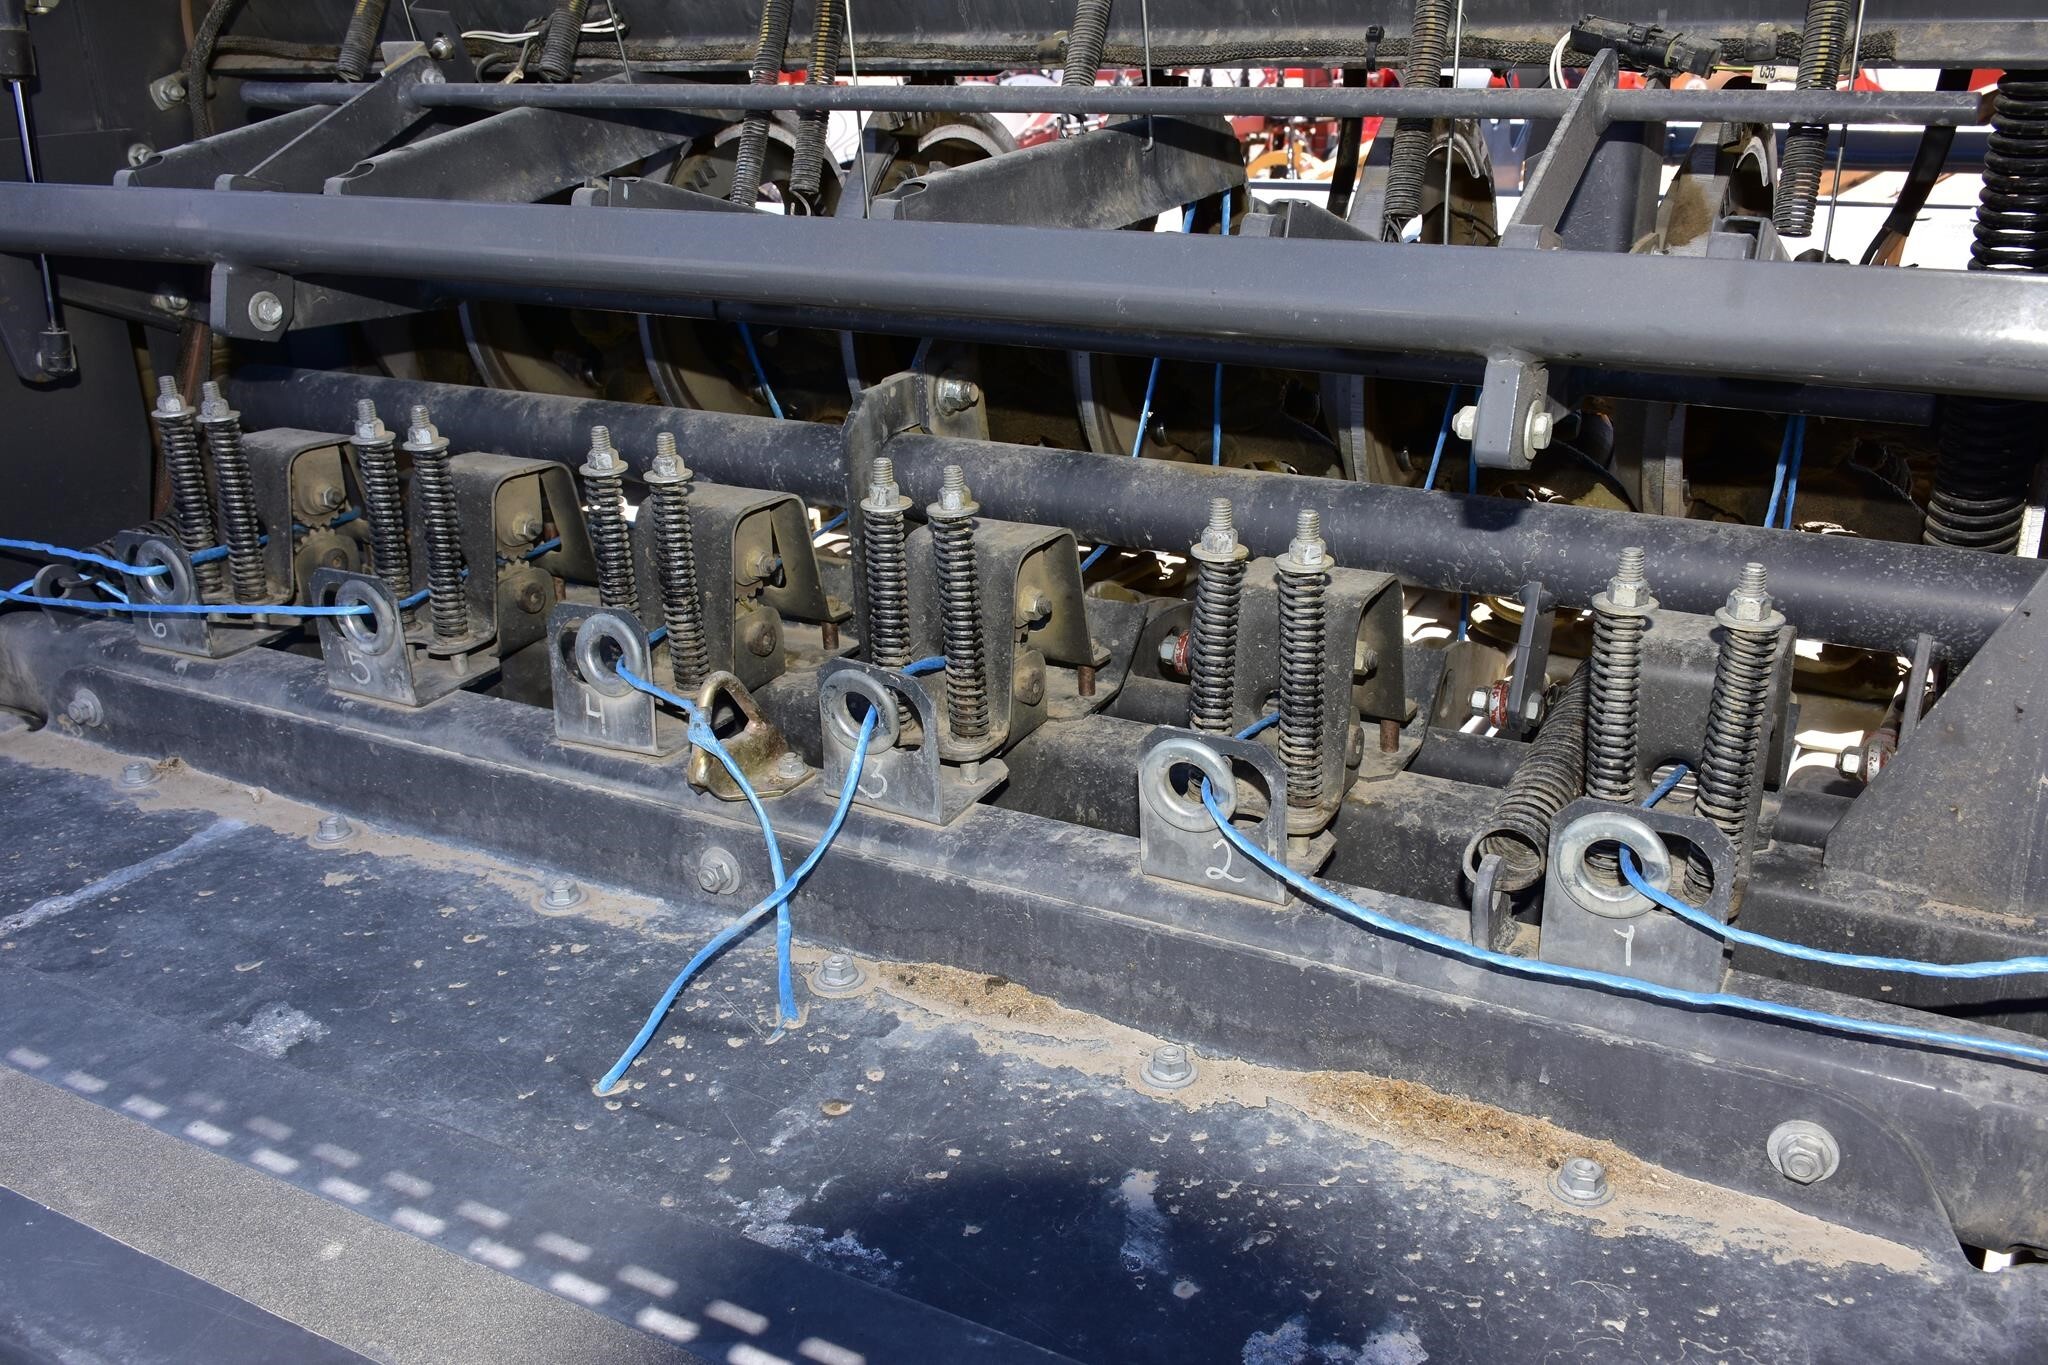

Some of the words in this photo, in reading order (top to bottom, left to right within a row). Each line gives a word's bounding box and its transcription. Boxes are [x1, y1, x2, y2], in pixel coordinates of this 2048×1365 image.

[148, 609, 167, 638] 6
[347, 650, 371, 685] 5
[585, 693, 607, 737] 4
[857, 759, 888, 799] 3
[1205, 838, 1246, 883] 2
[1613, 924, 1635, 967] 1
